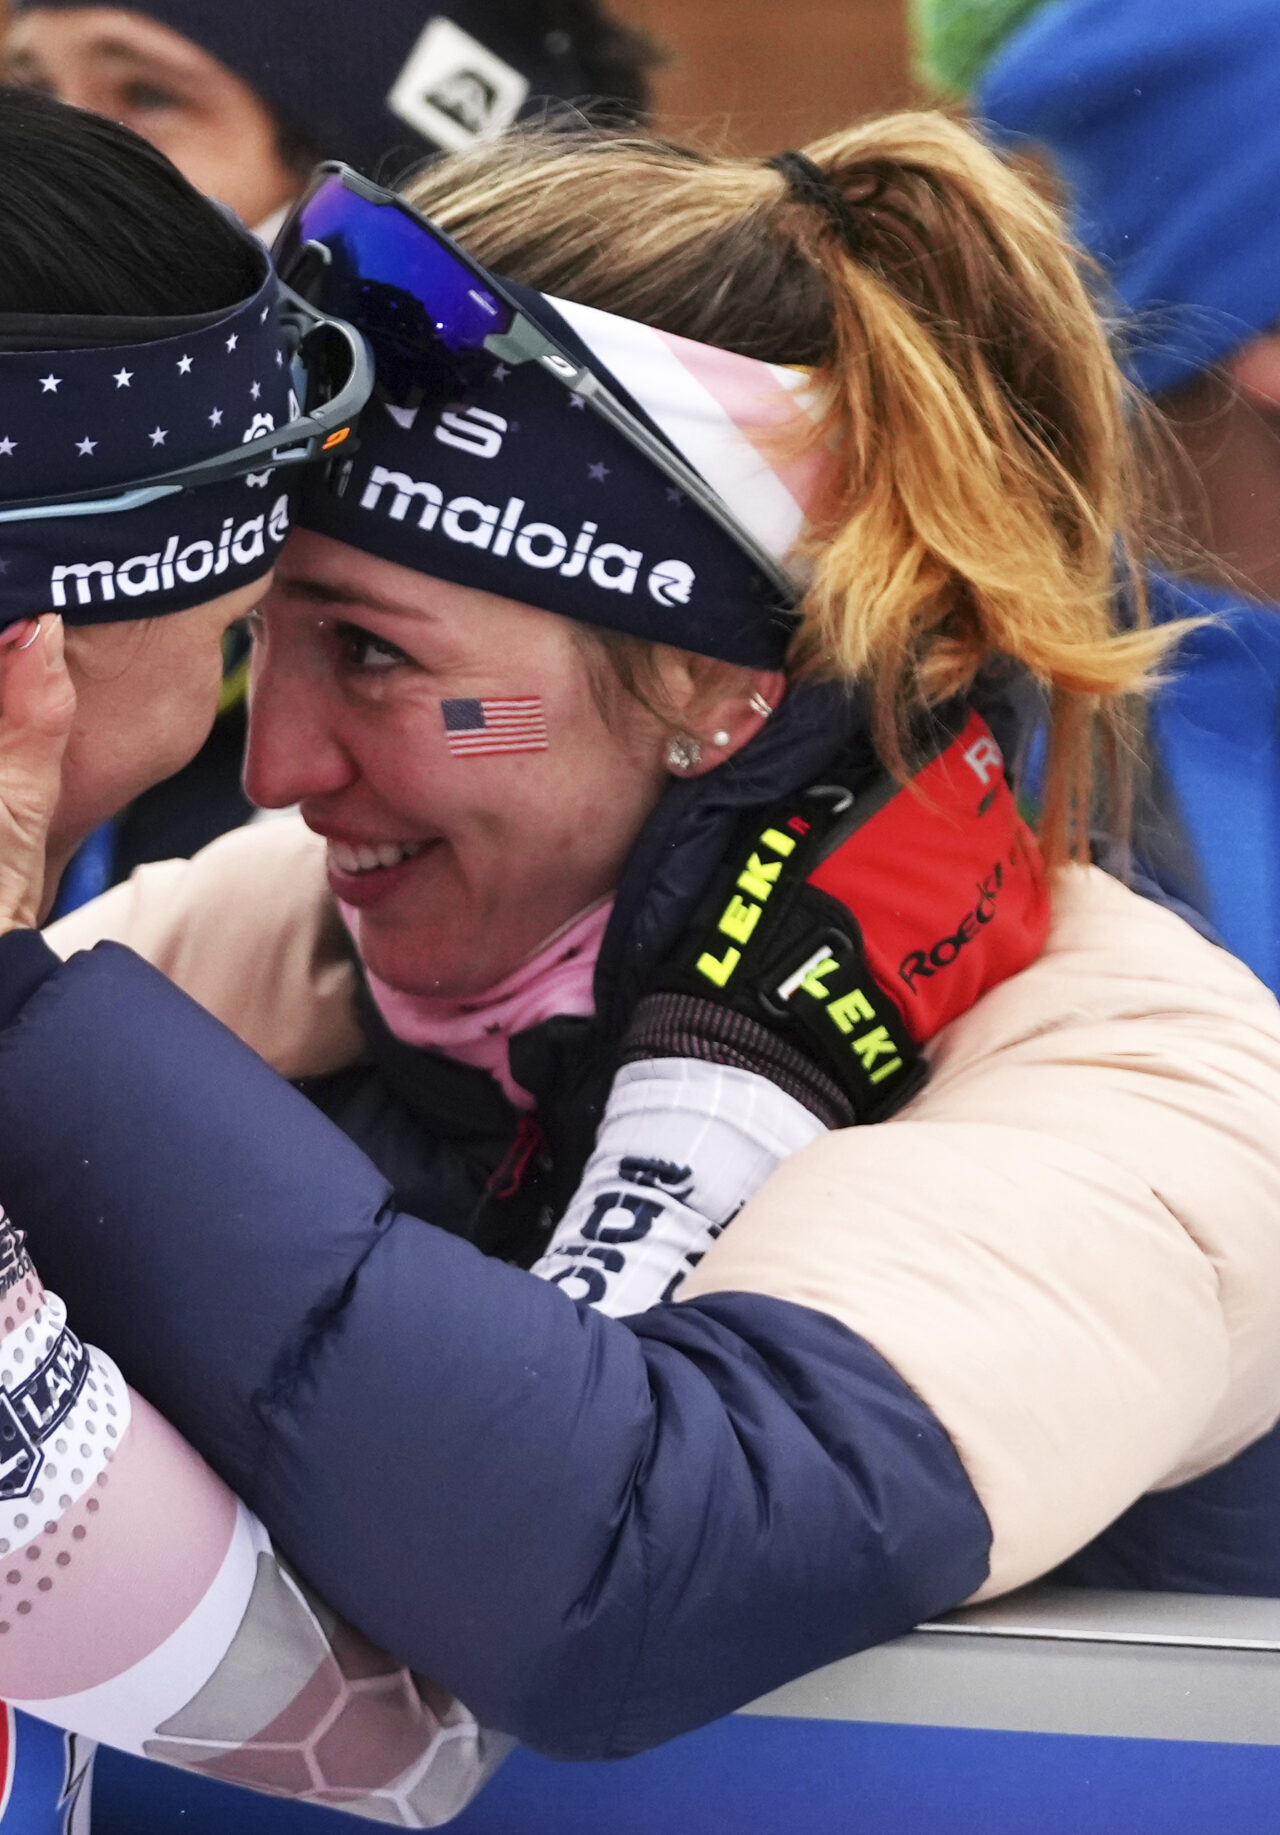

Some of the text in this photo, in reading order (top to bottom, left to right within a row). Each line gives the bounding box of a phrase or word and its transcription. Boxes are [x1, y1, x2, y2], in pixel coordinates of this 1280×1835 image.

[50, 514, 265, 607] maloja
[360, 465, 642, 594] maloja
[696, 827, 797, 988] LEKI
[799, 956, 904, 1086] LEKI
